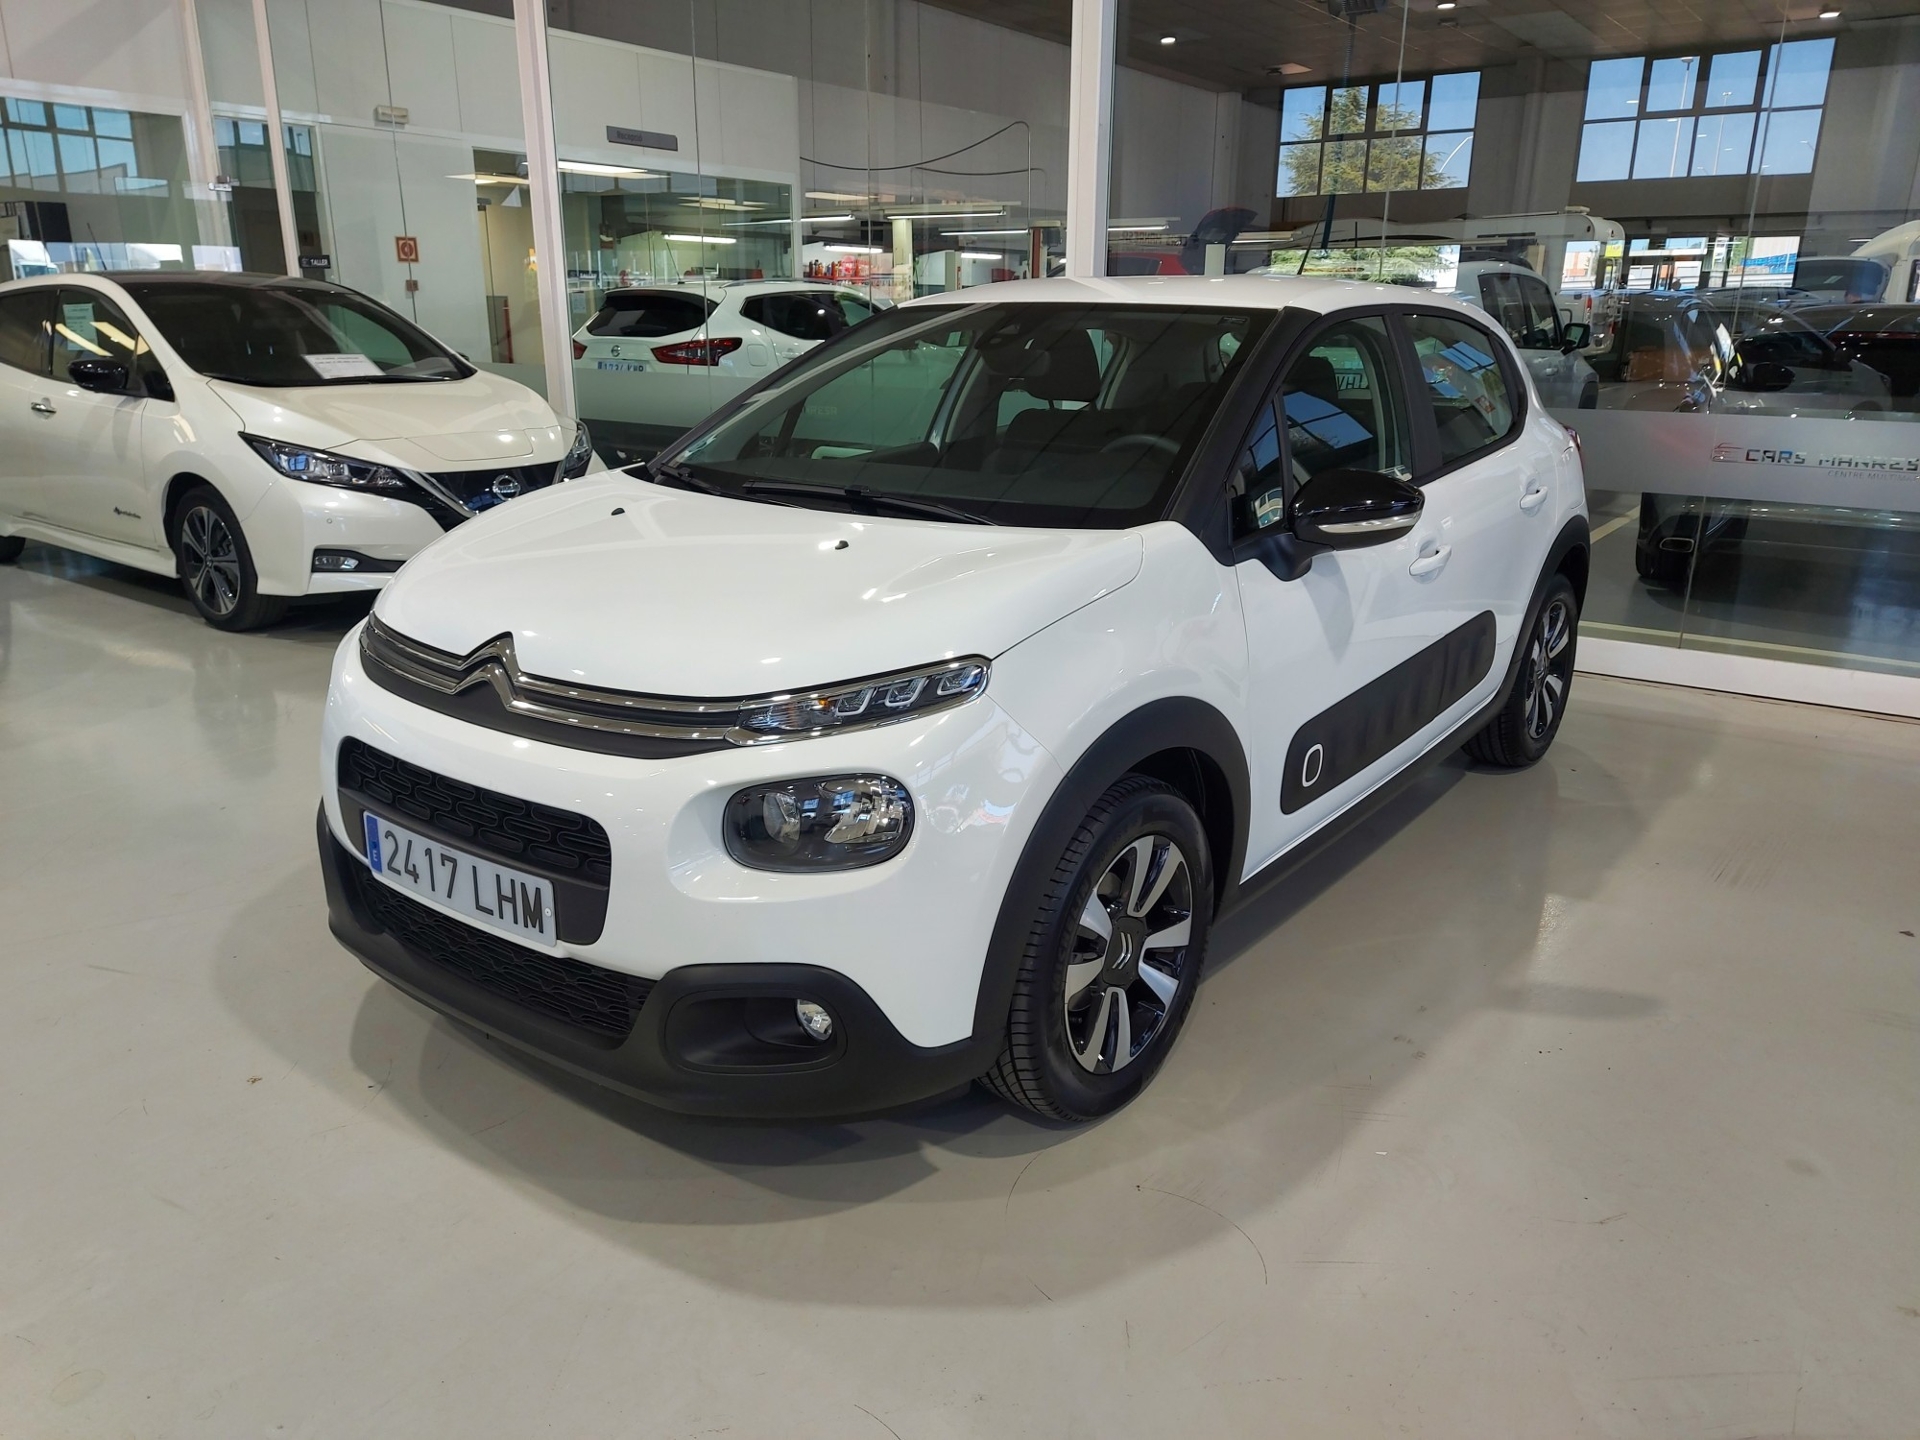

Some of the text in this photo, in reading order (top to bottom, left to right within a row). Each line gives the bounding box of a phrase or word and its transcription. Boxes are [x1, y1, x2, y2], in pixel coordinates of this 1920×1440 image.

[1745, 449, 1807, 465] CARS
[1827, 470, 1864, 480] CENTRE
[384, 829, 545, 935] 2417 LHM
